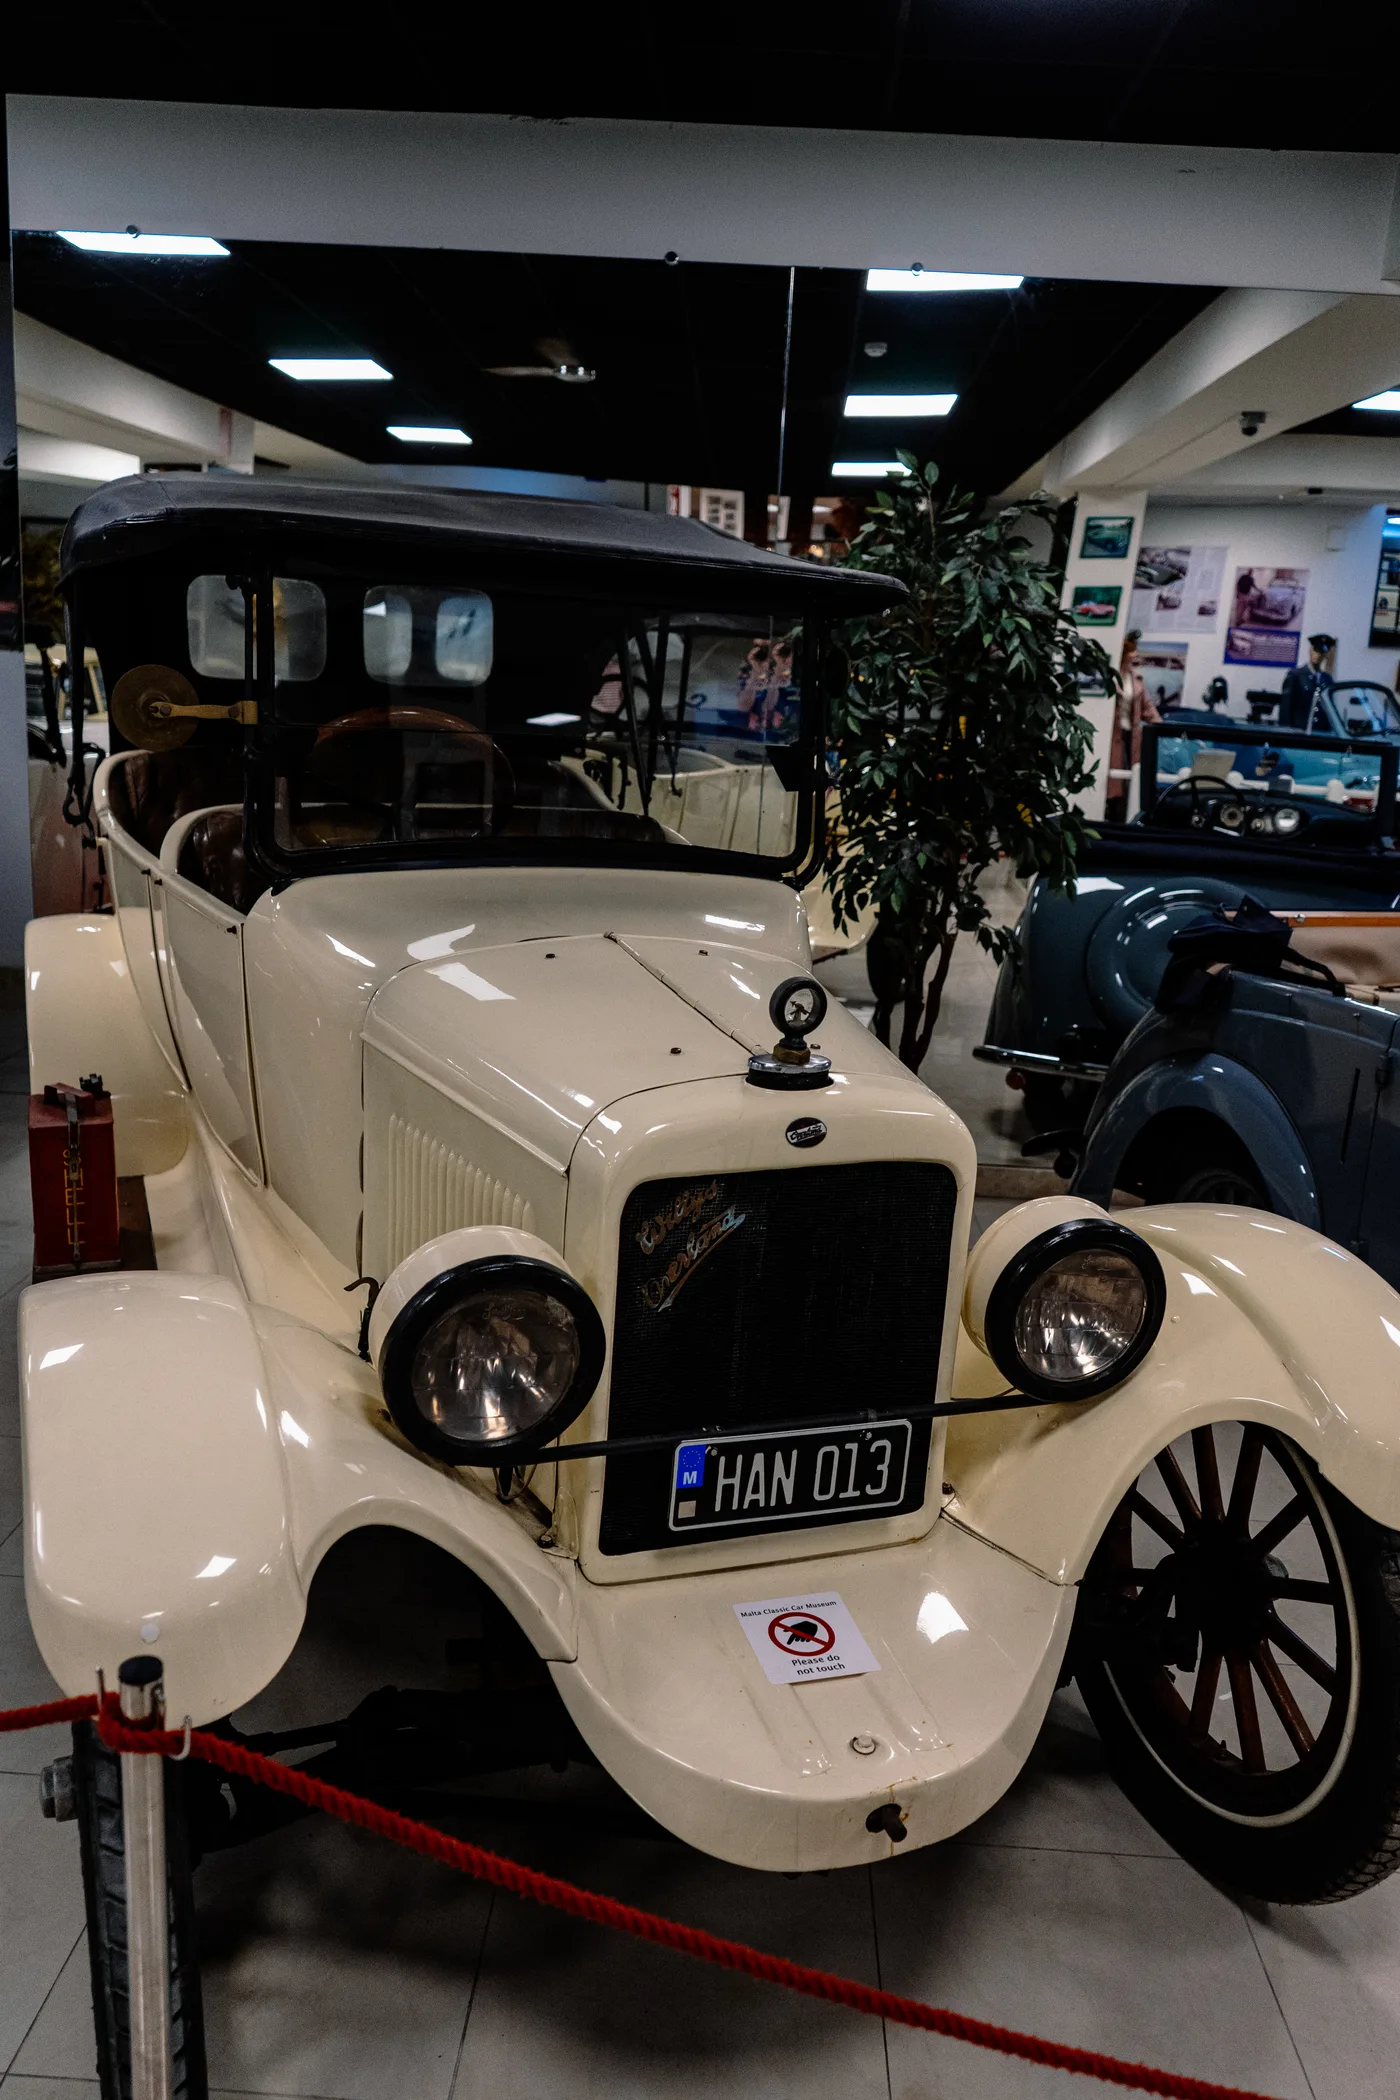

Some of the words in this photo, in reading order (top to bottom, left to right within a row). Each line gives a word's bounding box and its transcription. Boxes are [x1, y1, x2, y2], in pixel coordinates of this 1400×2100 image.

[682, 1471, 698, 1485] M
[714, 1449, 798, 1512] HAN
[813, 1439, 892, 1501] 013
[740, 1610, 762, 1618] Malta
[763, 1606, 790, 1615] Classic
[805, 1600, 837, 1609] Museum
[791, 1657, 824, 1667] Please
[827, 1654, 840, 1662] do
[796, 1667, 814, 1676] not
[816, 1662, 846, 1672] touch
